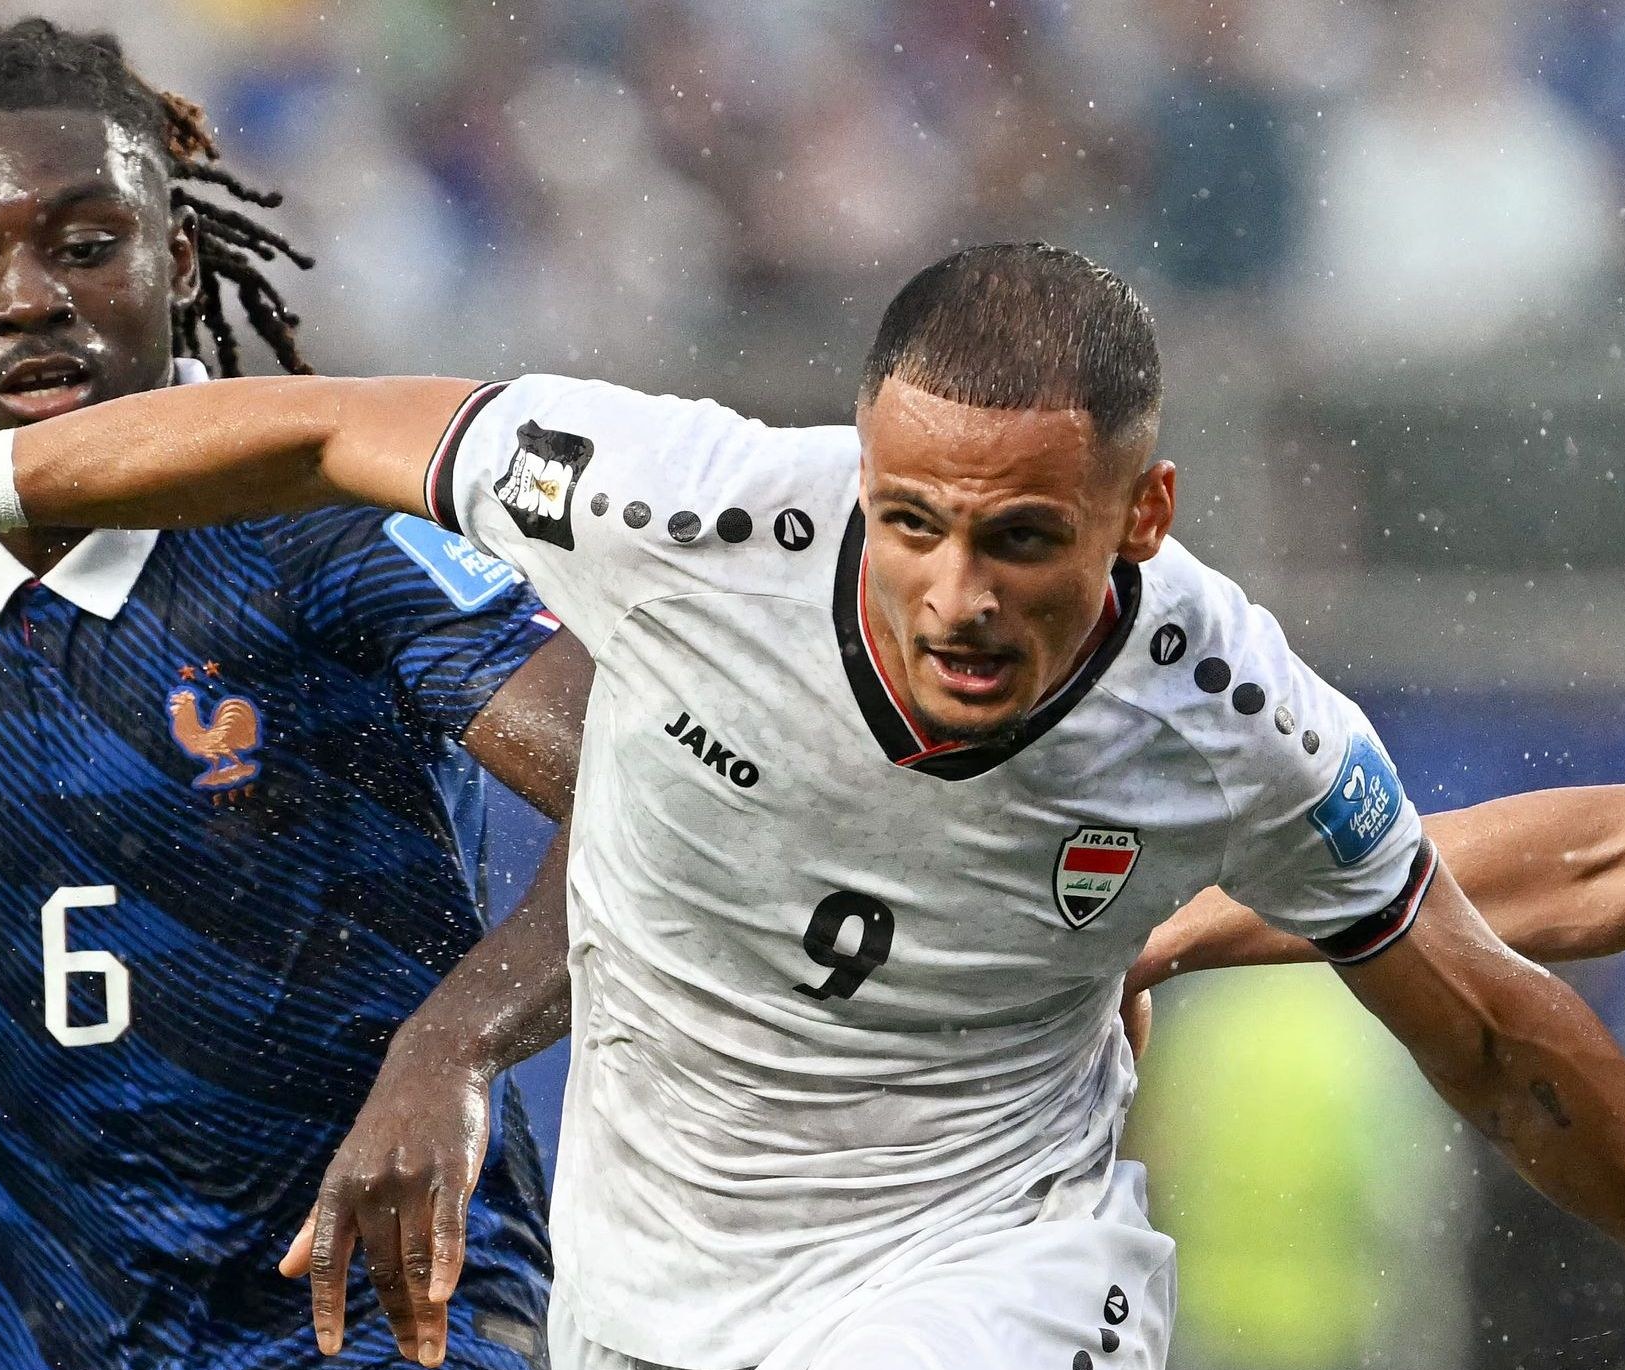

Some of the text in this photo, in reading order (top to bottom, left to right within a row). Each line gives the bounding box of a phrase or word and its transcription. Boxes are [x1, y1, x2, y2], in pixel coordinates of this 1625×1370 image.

[664, 712, 759, 788] JAKO
[1082, 833, 1129, 847] IRAQ
[1357, 787, 1390, 839] PEACE
[1370, 813, 1389, 838] FIFA
[41, 885, 130, 1047] 6
[792, 890, 895, 1000] 9
